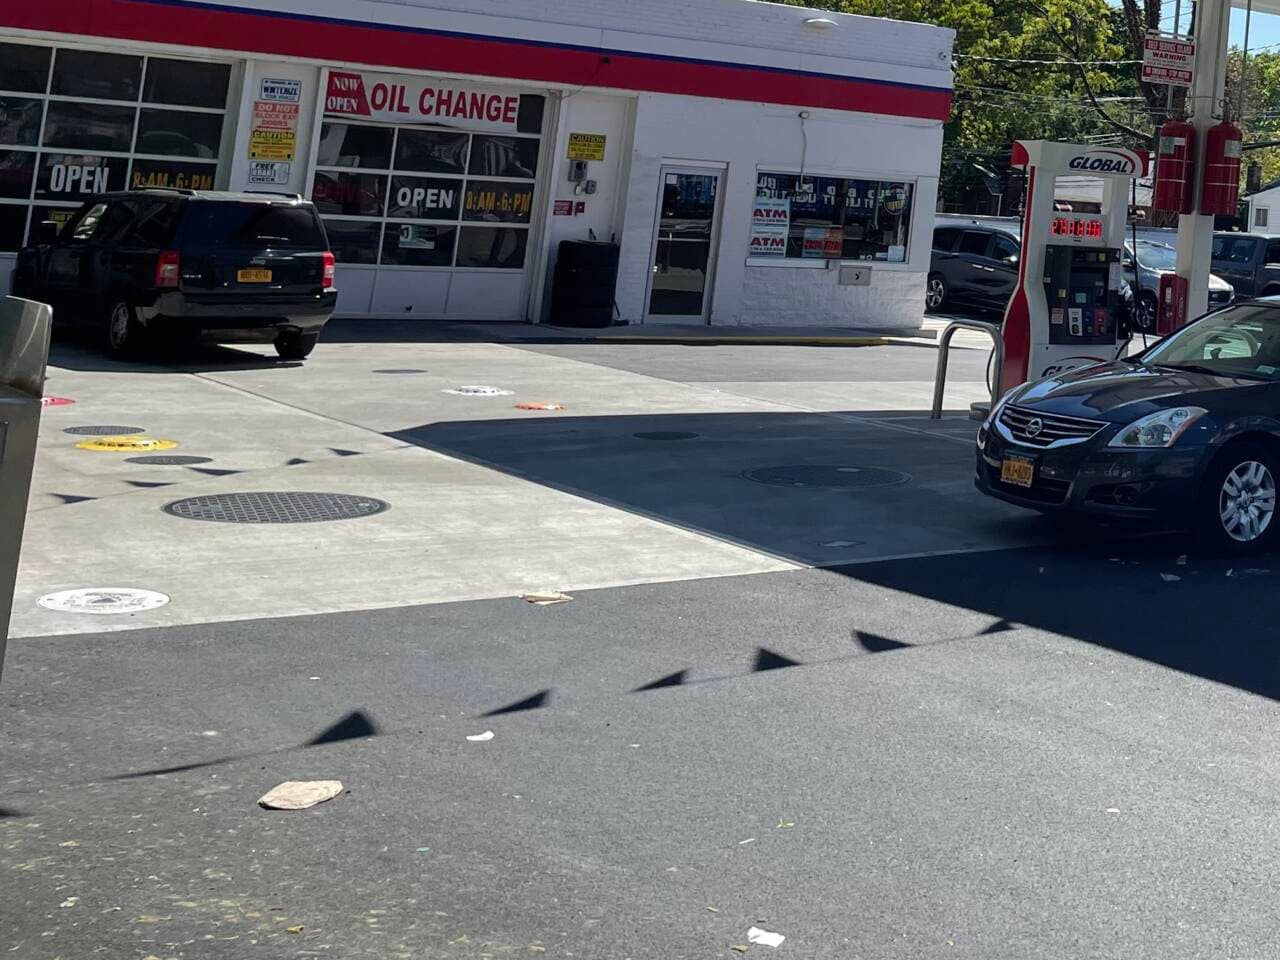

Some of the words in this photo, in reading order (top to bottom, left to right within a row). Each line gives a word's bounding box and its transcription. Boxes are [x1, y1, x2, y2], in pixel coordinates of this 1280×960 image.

[1152, 51, 1187, 62] WARNING
[331, 76, 359, 91] NOW
[257, 103, 273, 111] DO
[276, 104, 296, 113] NOT
[327, 96, 359, 112] OPEN
[370, 83, 410, 114] OIL
[418, 87, 518, 124] CHANGE
[253, 131, 294, 140] CAUTION
[571, 134, 603, 143] CAUTION
[1069, 156, 1129, 173] GLOBAL
[49, 164, 110, 194] OPEN
[396, 187, 454, 209] OPEN
[753, 208, 788, 219] ATM
[750, 237, 785, 248] ATM
